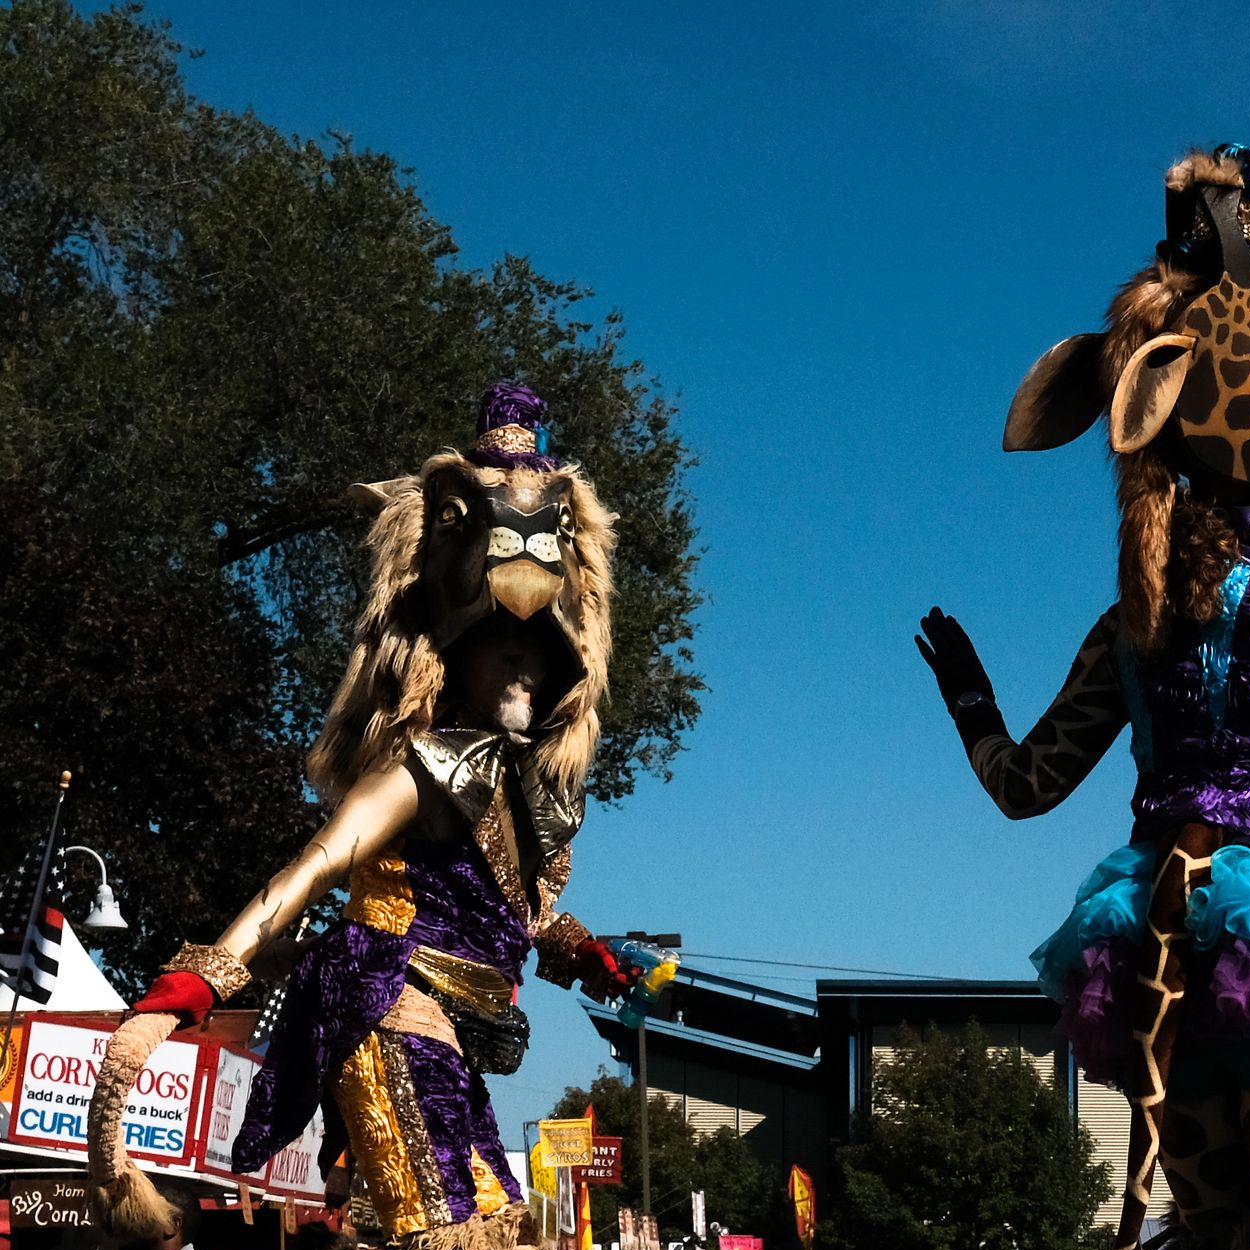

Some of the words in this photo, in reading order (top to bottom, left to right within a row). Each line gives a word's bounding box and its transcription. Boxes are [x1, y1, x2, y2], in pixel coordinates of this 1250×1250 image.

[136, 1067, 189, 1100] OGS
[56, 1095, 63, 1103] a
[139, 1105, 148, 1115] a
[20, 1108, 88, 1138] CURL
[581, 1169, 613, 1177] FRIES
[11, 1190, 42, 1215] Big
[34, 1201, 79, 1226] Corn
